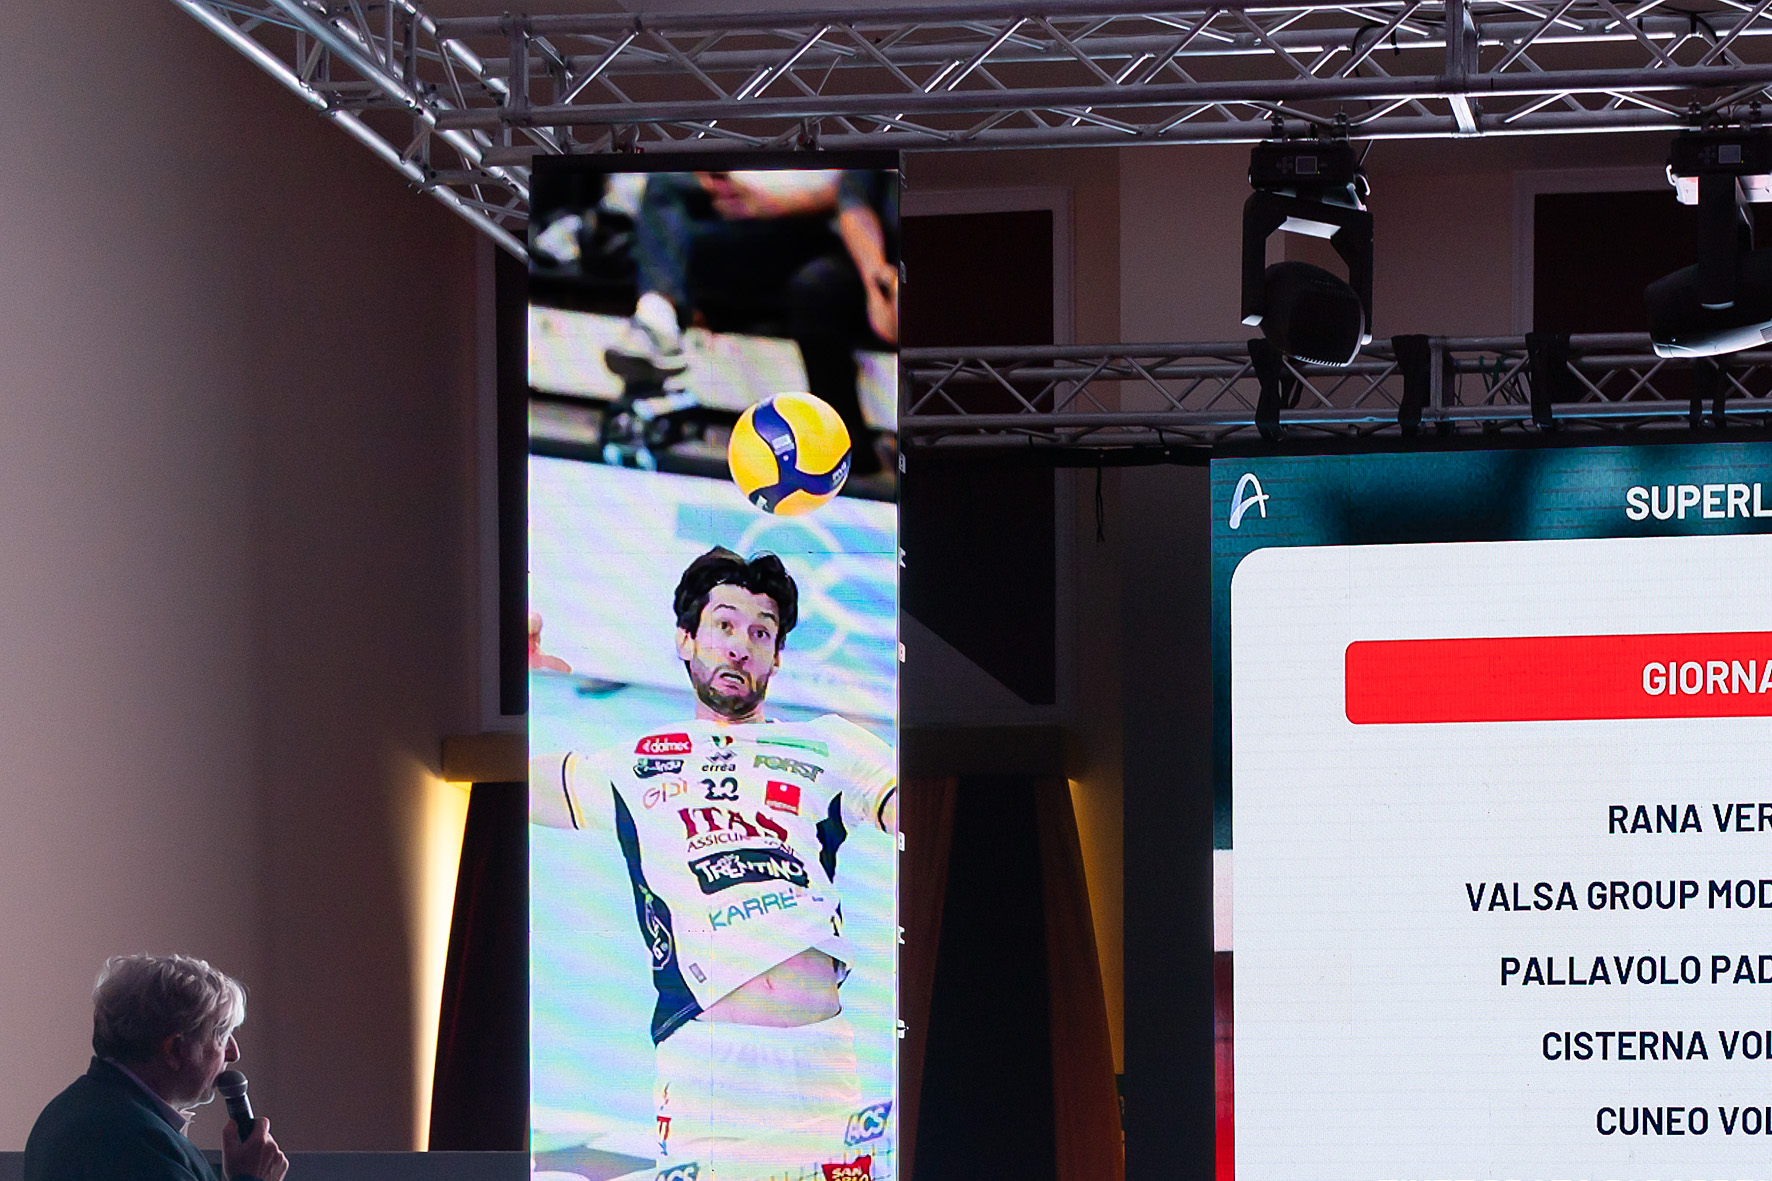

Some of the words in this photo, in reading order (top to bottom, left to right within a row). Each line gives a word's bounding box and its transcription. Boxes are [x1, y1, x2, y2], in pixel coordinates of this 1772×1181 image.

[1609, 804, 1702, 834] RANA
[696, 855, 803, 884] TRENTINO
[1466, 882, 1578, 911] VALSA
[1588, 881, 1699, 910] GROUP
[1501, 956, 1700, 986] PALLAVOLO
[1543, 1031, 1708, 1060] CISTERNA
[846, 1107, 886, 1143] ACS
[1597, 1107, 1708, 1135] CUNEO
